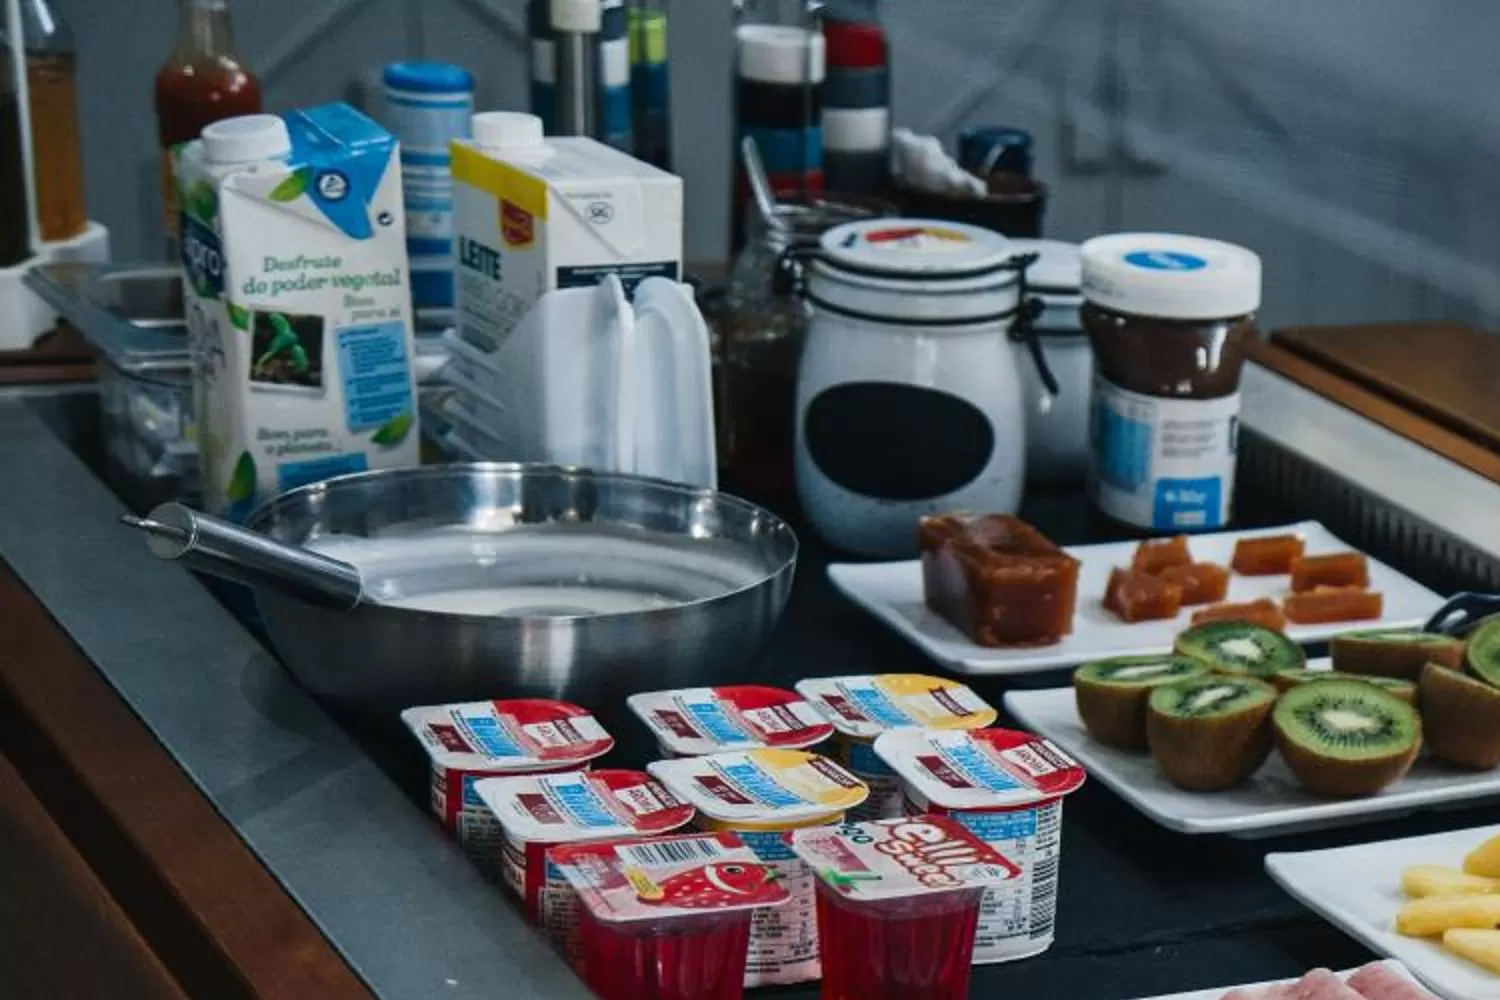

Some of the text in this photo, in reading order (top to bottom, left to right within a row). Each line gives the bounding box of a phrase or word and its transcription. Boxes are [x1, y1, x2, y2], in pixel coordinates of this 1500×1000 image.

[458, 234, 502, 281] LEITE
[242, 267, 401, 296] do poder vegetal
